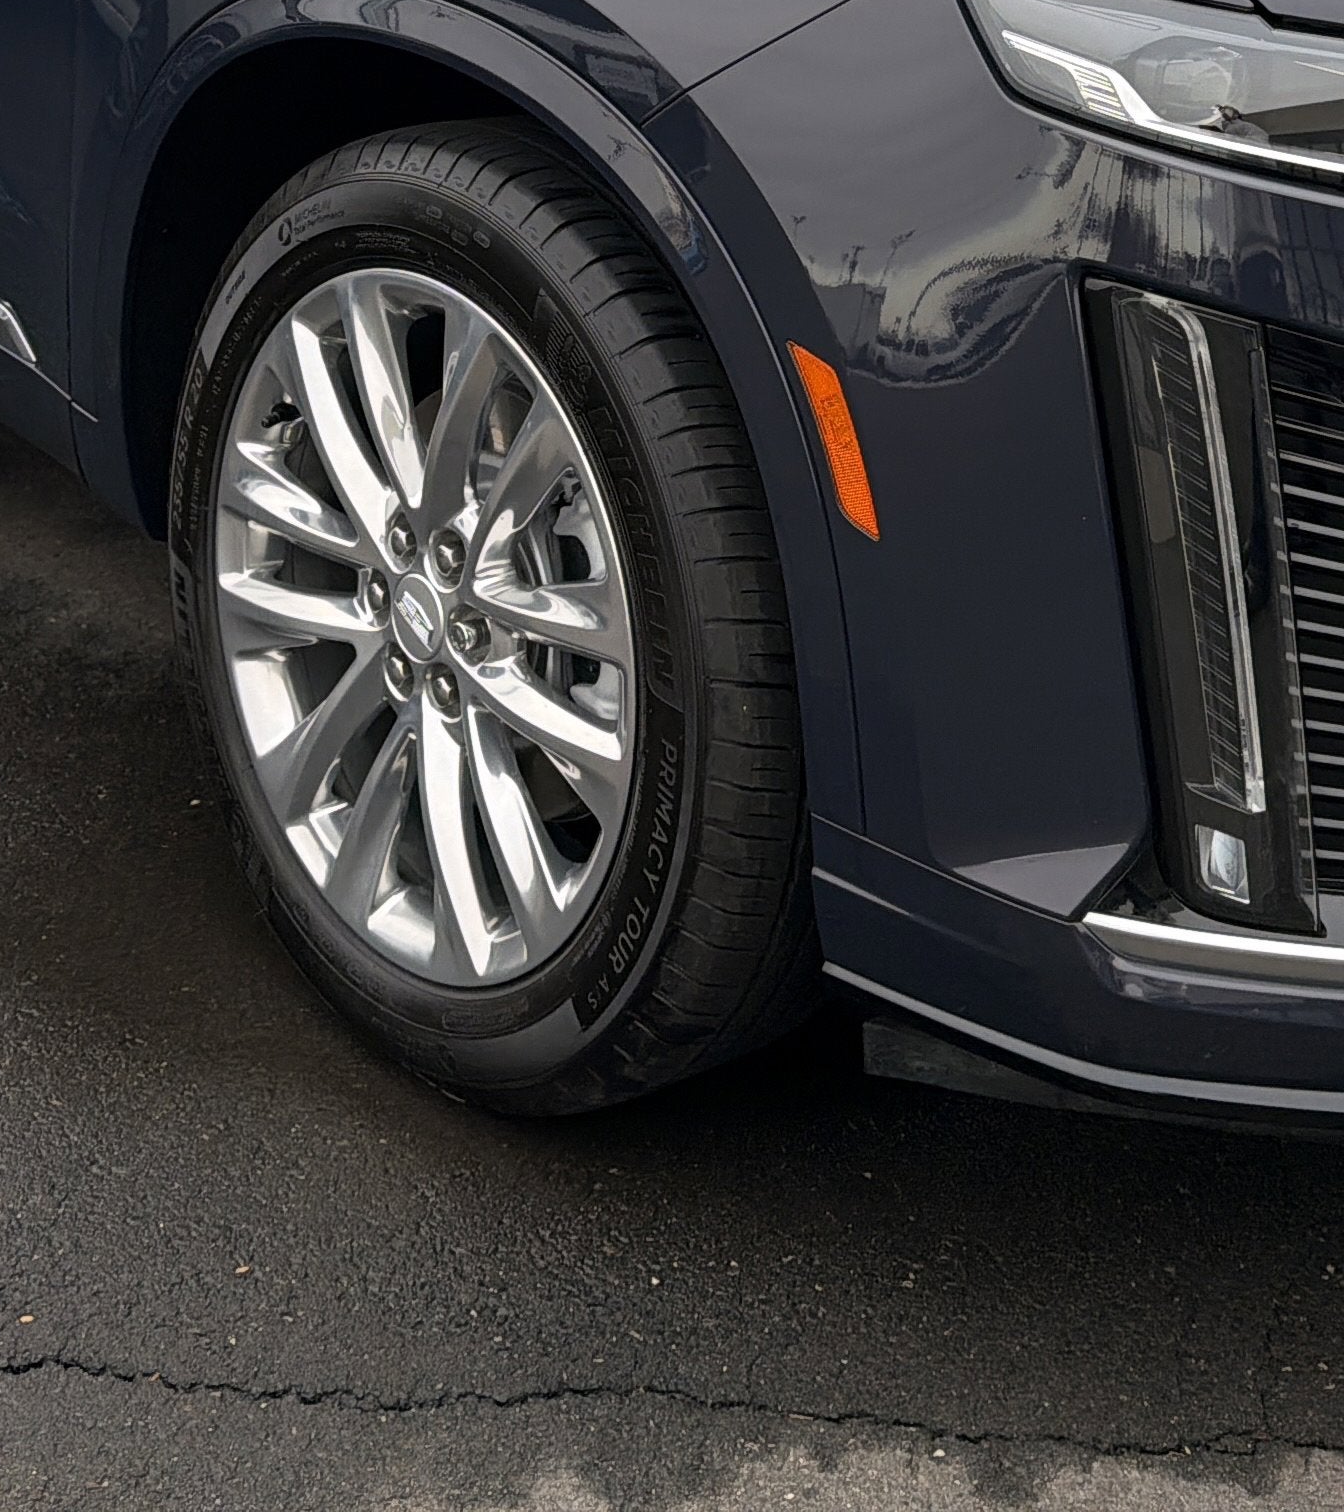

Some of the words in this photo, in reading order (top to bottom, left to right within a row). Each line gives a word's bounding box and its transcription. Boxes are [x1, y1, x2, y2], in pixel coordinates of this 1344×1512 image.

[183, 410, 195, 431] R
[191, 366, 204, 406] 20
[589, 405, 676, 683] MICHELIN
[643, 737, 679, 895] PRIMACY
[607, 896, 651, 975] TOUR
[586, 972, 611, 1011] A/S
